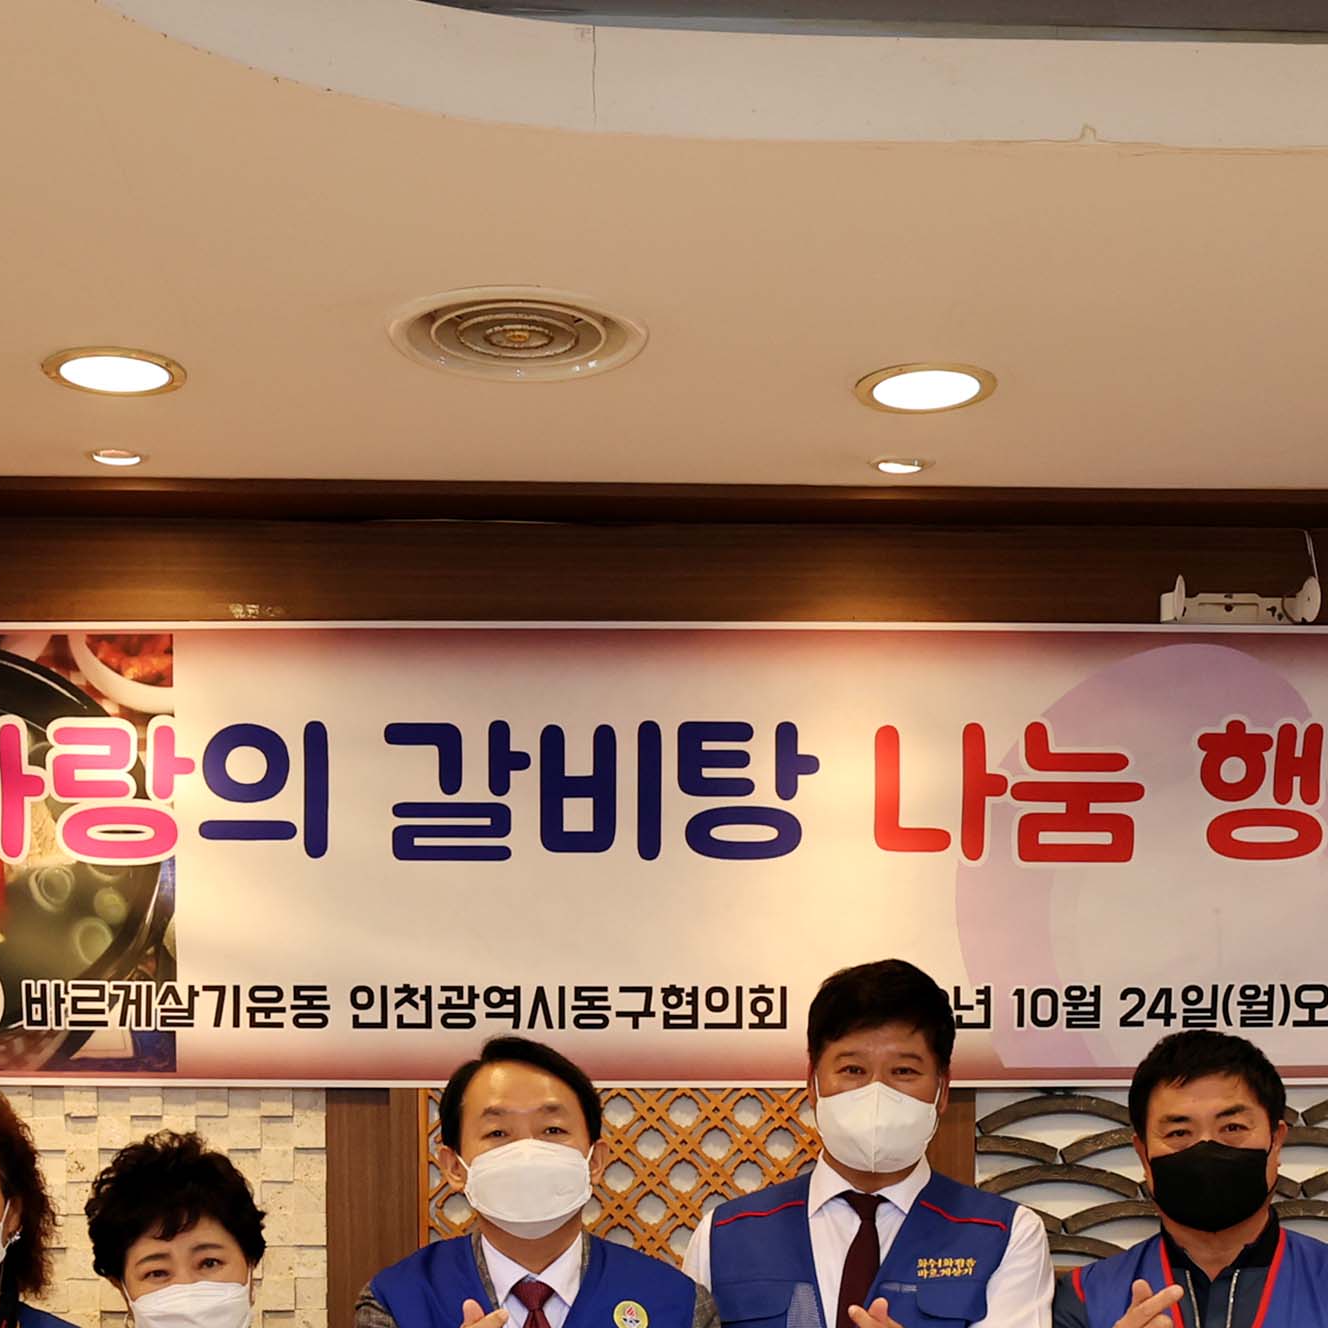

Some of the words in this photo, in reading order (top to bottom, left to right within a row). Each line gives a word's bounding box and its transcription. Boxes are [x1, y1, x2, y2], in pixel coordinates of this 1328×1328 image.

[383, 719, 821, 861] 갈비탕
[873, 720, 1146, 863] 나눔
[22, 981, 330, 1030] 바르게살기운동
[349, 983, 787, 1031] 인천광역시동구협의회
[1012, 984, 1101, 1029] 10월
